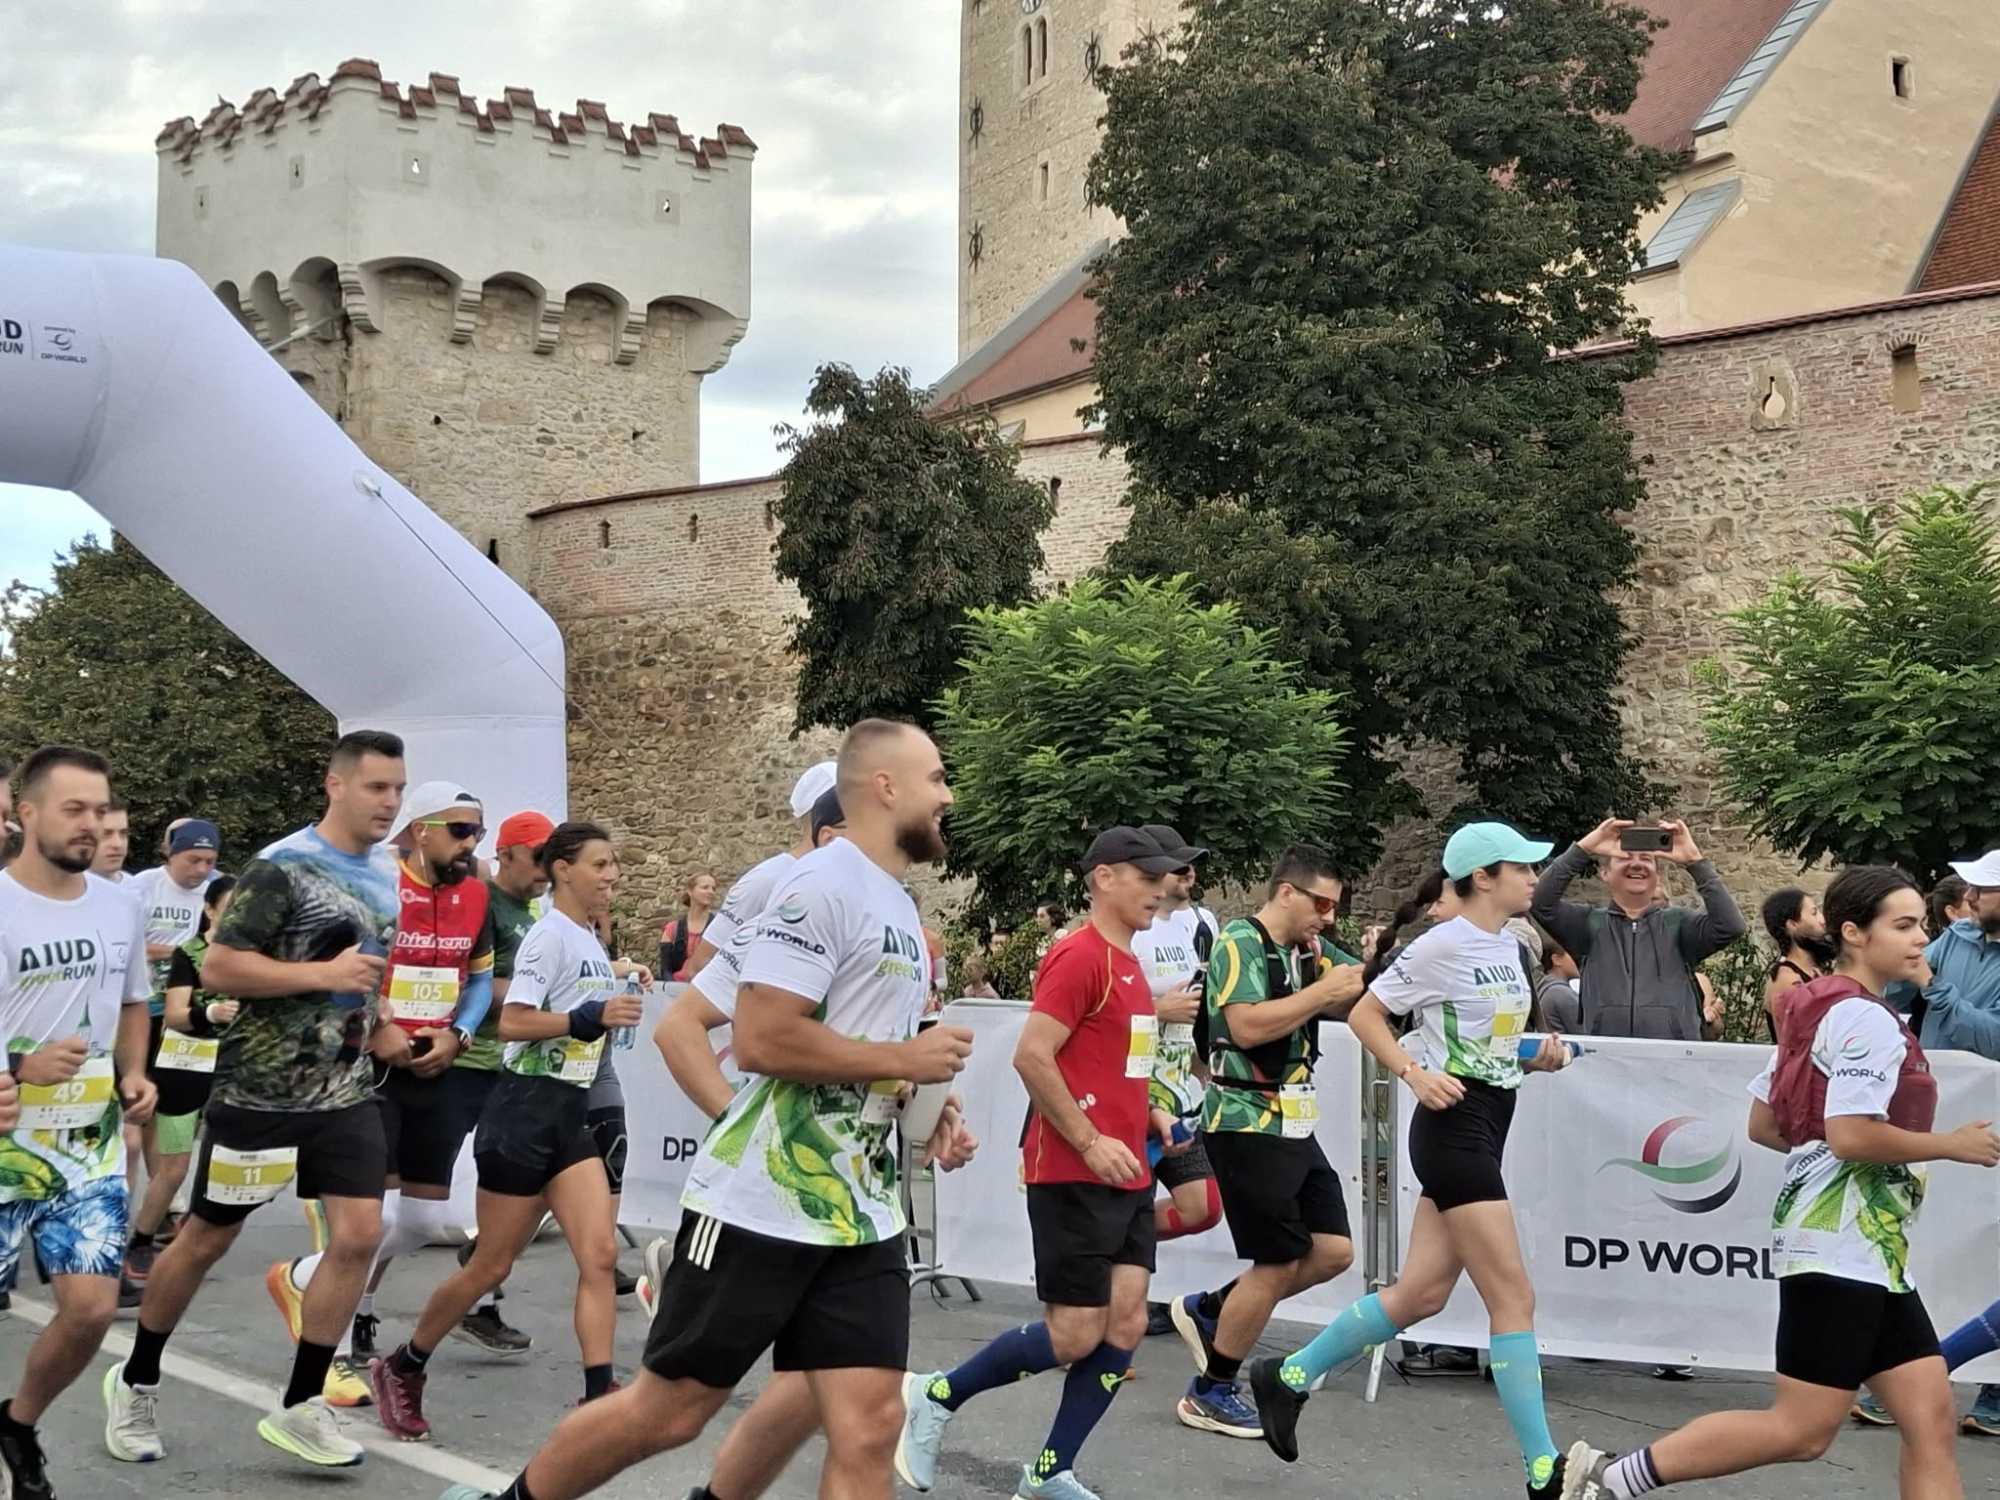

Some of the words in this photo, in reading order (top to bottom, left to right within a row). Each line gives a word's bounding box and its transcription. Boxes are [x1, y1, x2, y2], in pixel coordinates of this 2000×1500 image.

[0, 319, 23, 340] D
[0, 341, 24, 355] UN
[151, 906, 192, 921] AIUD
[767, 927, 826, 955] WORLD
[19, 938, 96, 973] AIUD
[1154, 945, 1186, 963] AIUD
[1474, 965, 1516, 986] AIUD
[412, 983, 443, 1001] 105
[1836, 1067, 1886, 1082] WORLD
[53, 1081, 86, 1103] 49
[663, 1135, 698, 1162] DP
[243, 1167, 262, 1185] 11
[1565, 1236, 1629, 1269] DP
[1638, 1240, 1775, 1280] WORL
